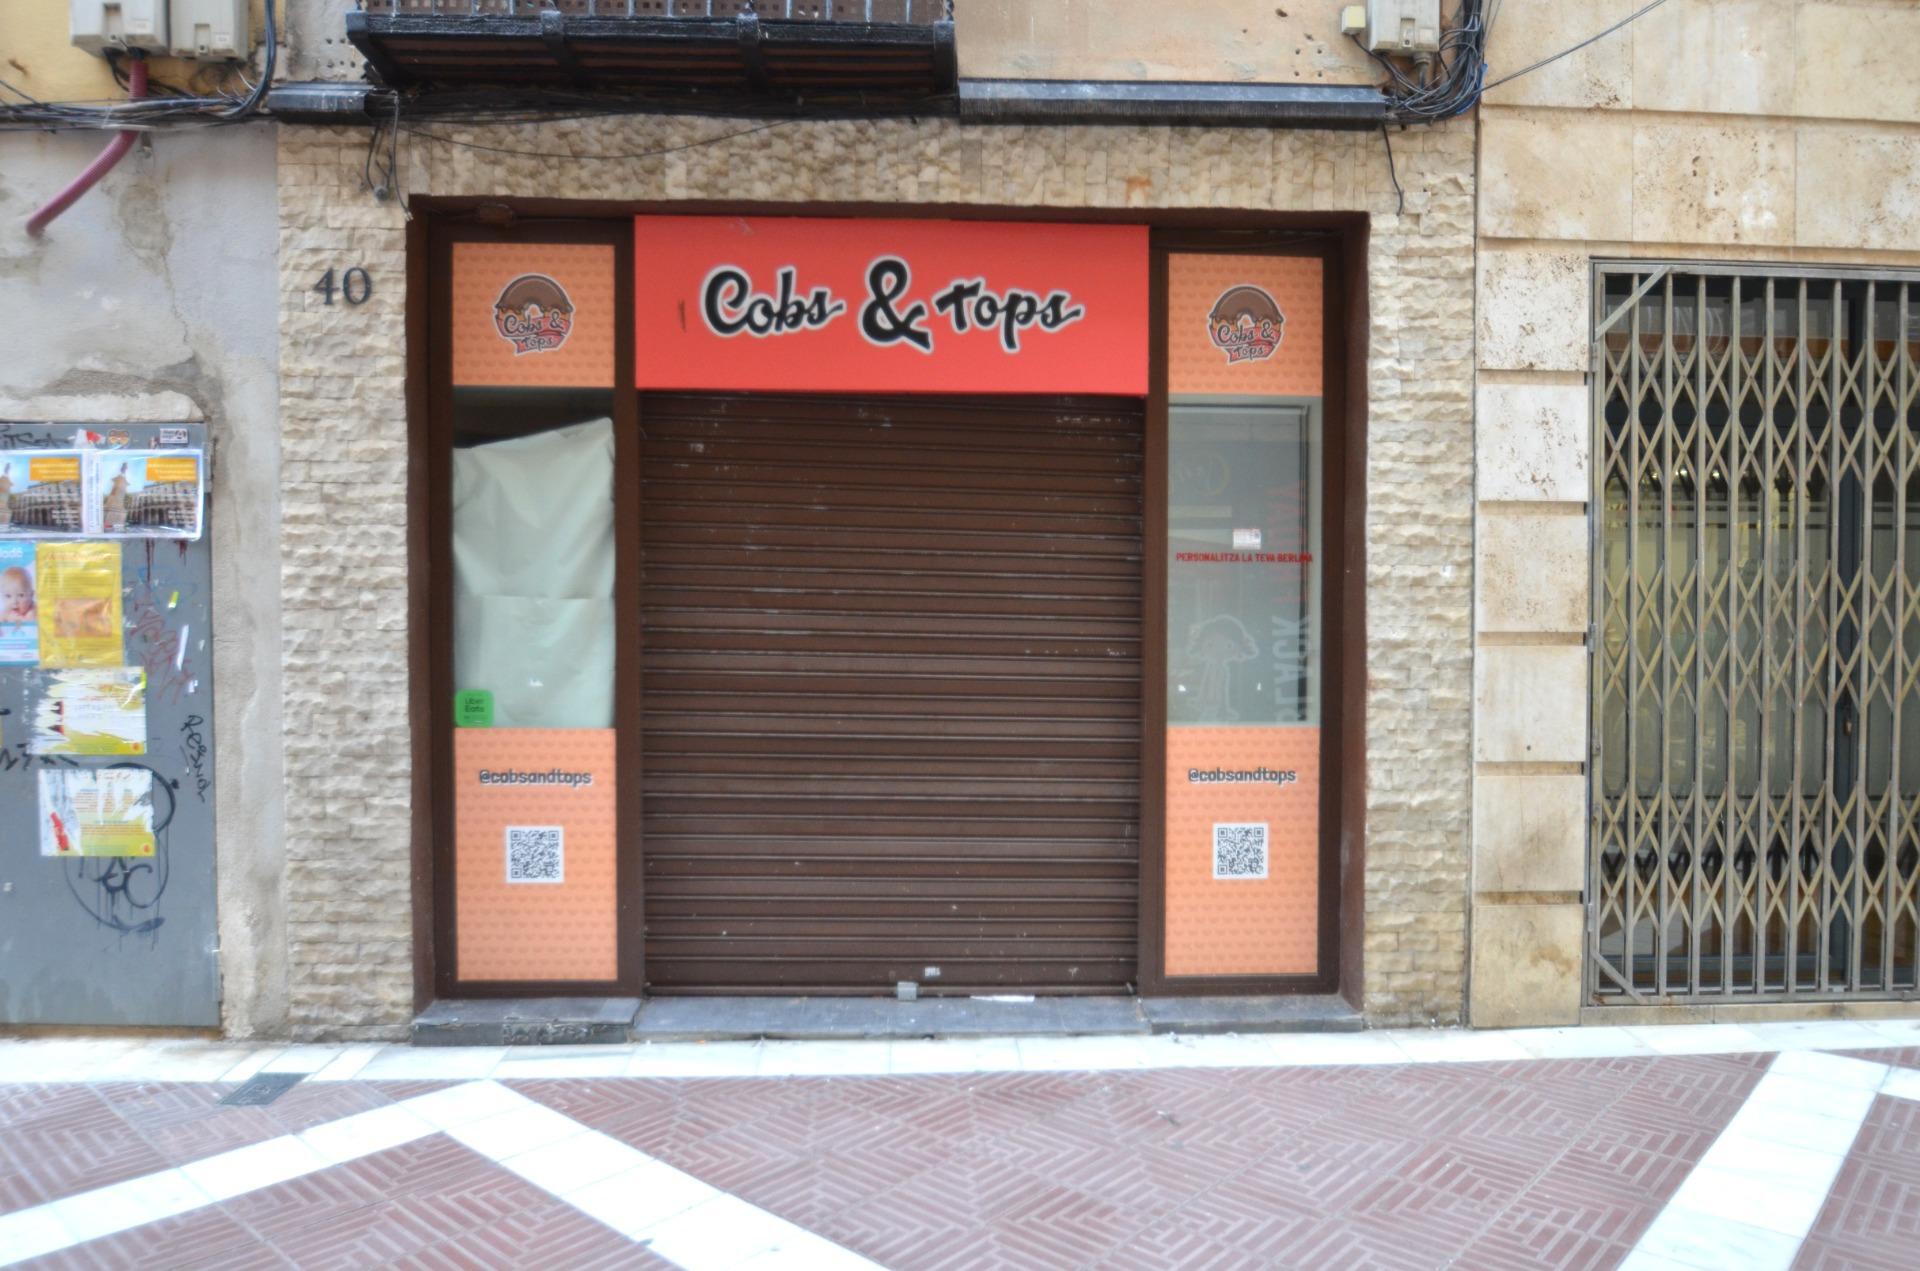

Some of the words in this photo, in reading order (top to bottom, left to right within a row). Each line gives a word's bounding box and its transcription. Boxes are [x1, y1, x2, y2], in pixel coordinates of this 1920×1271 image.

[313, 266, 373, 306] 40
[703, 268, 844, 335] Cobs
[860, 258, 931, 351] &
[935, 280, 1082, 350] Tops
[503, 314, 543, 335] Cobs
[549, 311, 565, 331] &
[1216, 324, 1255, 343] Cobs
[1260, 320, 1275, 340] &
[520, 335, 554, 351] Tops
[1233, 344, 1265, 361] Tops
[1175, 552, 1240, 563] PERSONALITZA
[1241, 552, 1253, 562] LA
[479, 768, 592, 788] @cobsandtops
[1188, 766, 1296, 786] @cobsandtops
